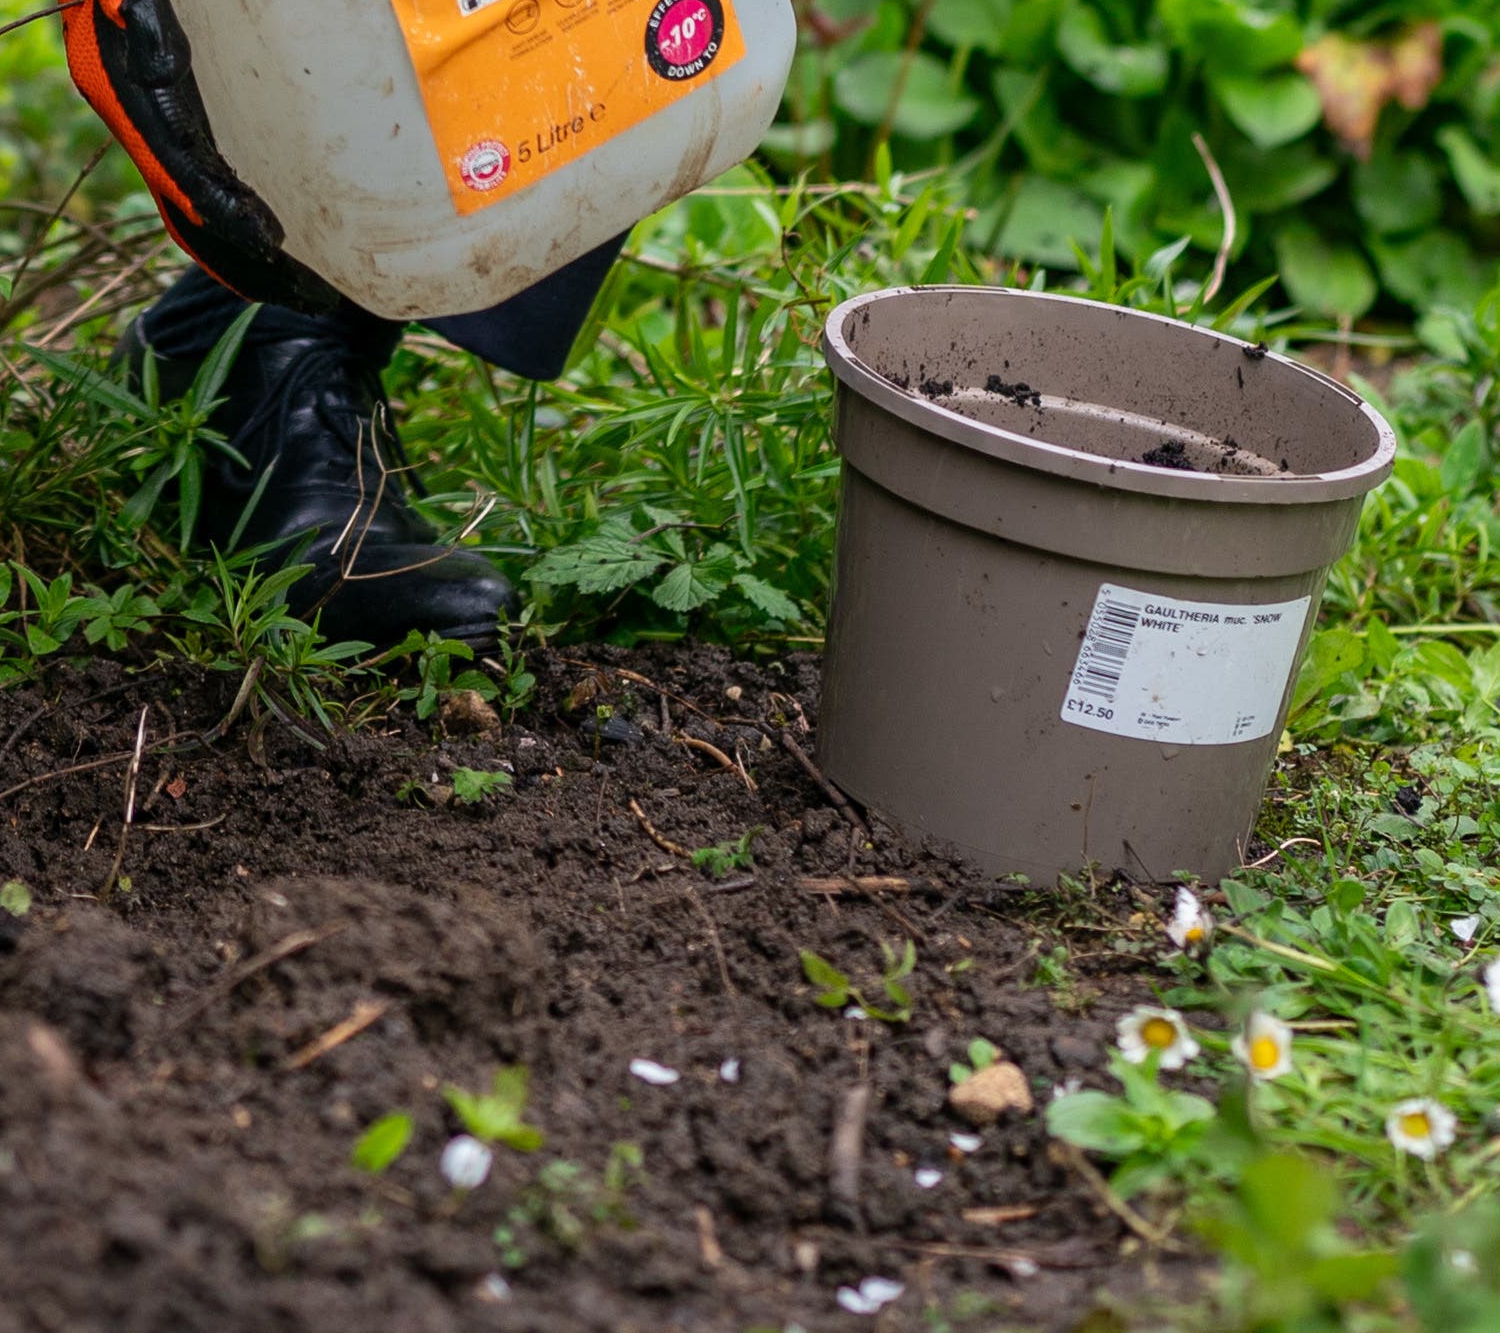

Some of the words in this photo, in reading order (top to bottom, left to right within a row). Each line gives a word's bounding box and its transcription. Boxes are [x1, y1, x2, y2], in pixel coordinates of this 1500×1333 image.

[666, 58, 704, 78] DOWN
[703, 41, 718, 59] TO
[517, 139, 532, 163] 5
[536, 116, 584, 154] Litre
[1143, 603, 1219, 624] GAULTHERIA
[1223, 616, 1248, 626] muc.
[1066, 698, 1115, 721] £12.50
